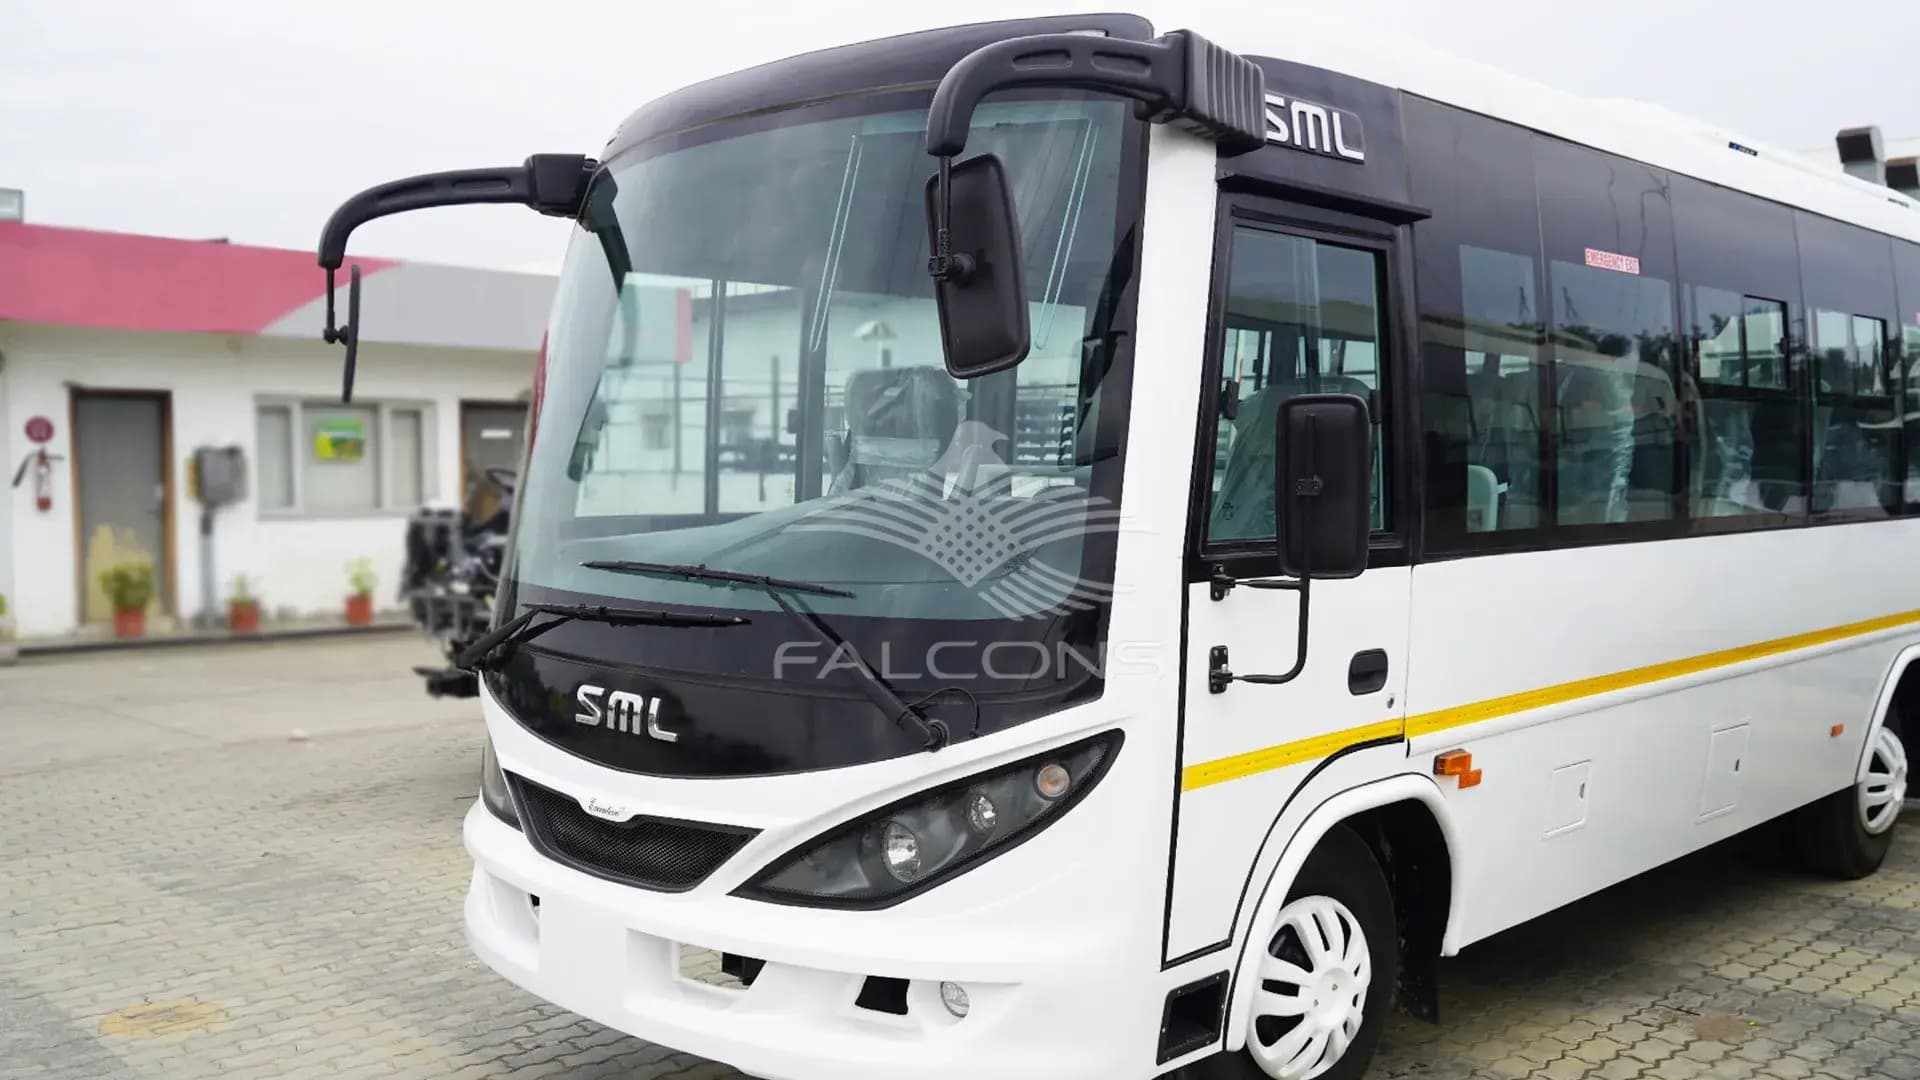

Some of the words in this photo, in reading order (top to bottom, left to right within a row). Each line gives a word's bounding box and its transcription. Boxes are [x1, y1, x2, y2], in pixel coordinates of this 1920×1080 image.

[1265, 93, 1365, 161] SML
[1586, 249, 1624, 270] EMERGENCY
[575, 684, 679, 743] SML
